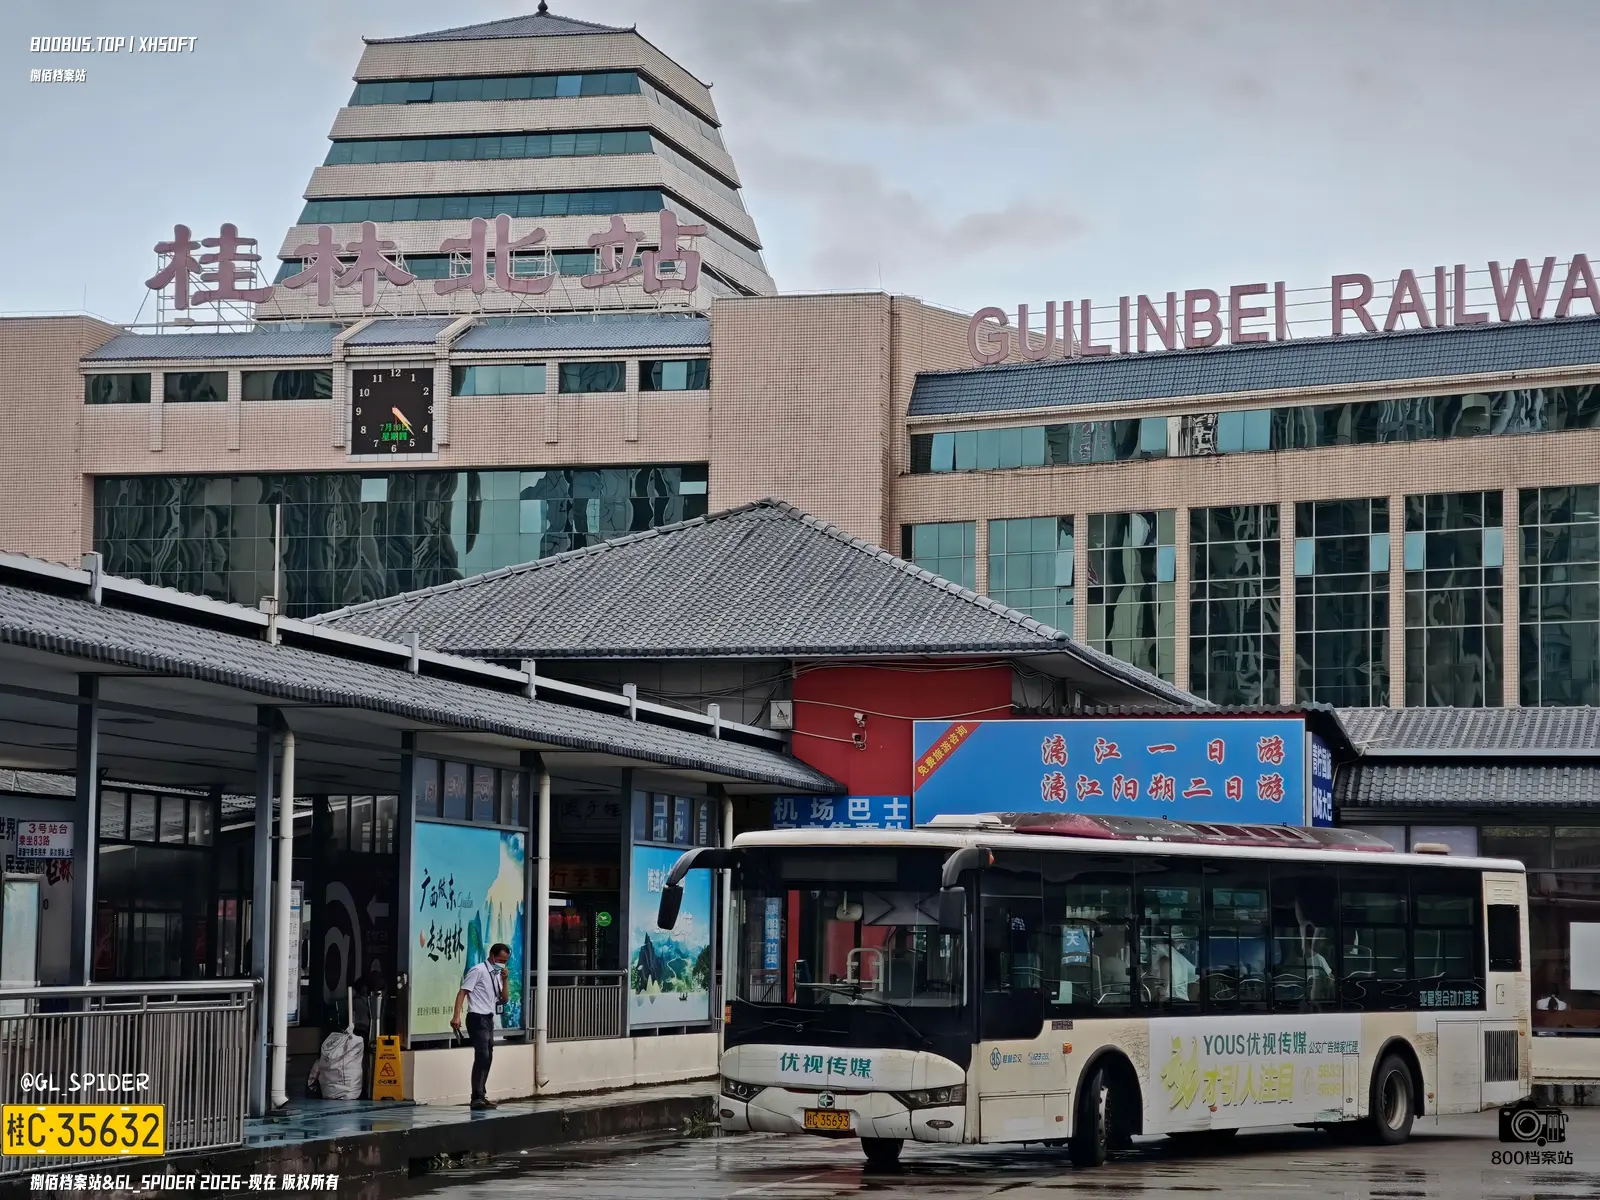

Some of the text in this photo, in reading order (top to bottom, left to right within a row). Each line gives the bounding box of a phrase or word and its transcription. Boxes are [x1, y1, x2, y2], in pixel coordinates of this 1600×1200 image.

[145, 209, 708, 311] 桂林北站
[967, 252, 1600, 365] GUILINBEI RAILWA
[390, 368, 401, 377] 12
[373, 374, 382, 383] 11
[411, 373, 416, 382] 1
[359, 388, 370, 397] 10
[423, 387, 429, 396] 2
[355, 407, 362, 416] 9
[427, 405, 434, 414] 3
[360, 425, 367, 434] 8
[422, 424, 428, 433] 4
[373, 439, 379, 448] 7
[409, 438, 415, 447] 5
[391, 445, 397, 453] 6
[916, 724, 968, 777] 免费旅游咨询
[1041, 733, 1285, 766] 漓江一日游
[1041, 771, 1285, 803] 漓江阳朔二日游
[774, 797, 908, 821] 机场巴士
[28, 823, 68, 835] 3号站台
[779, 1052, 872, 1079] 优视传媒
